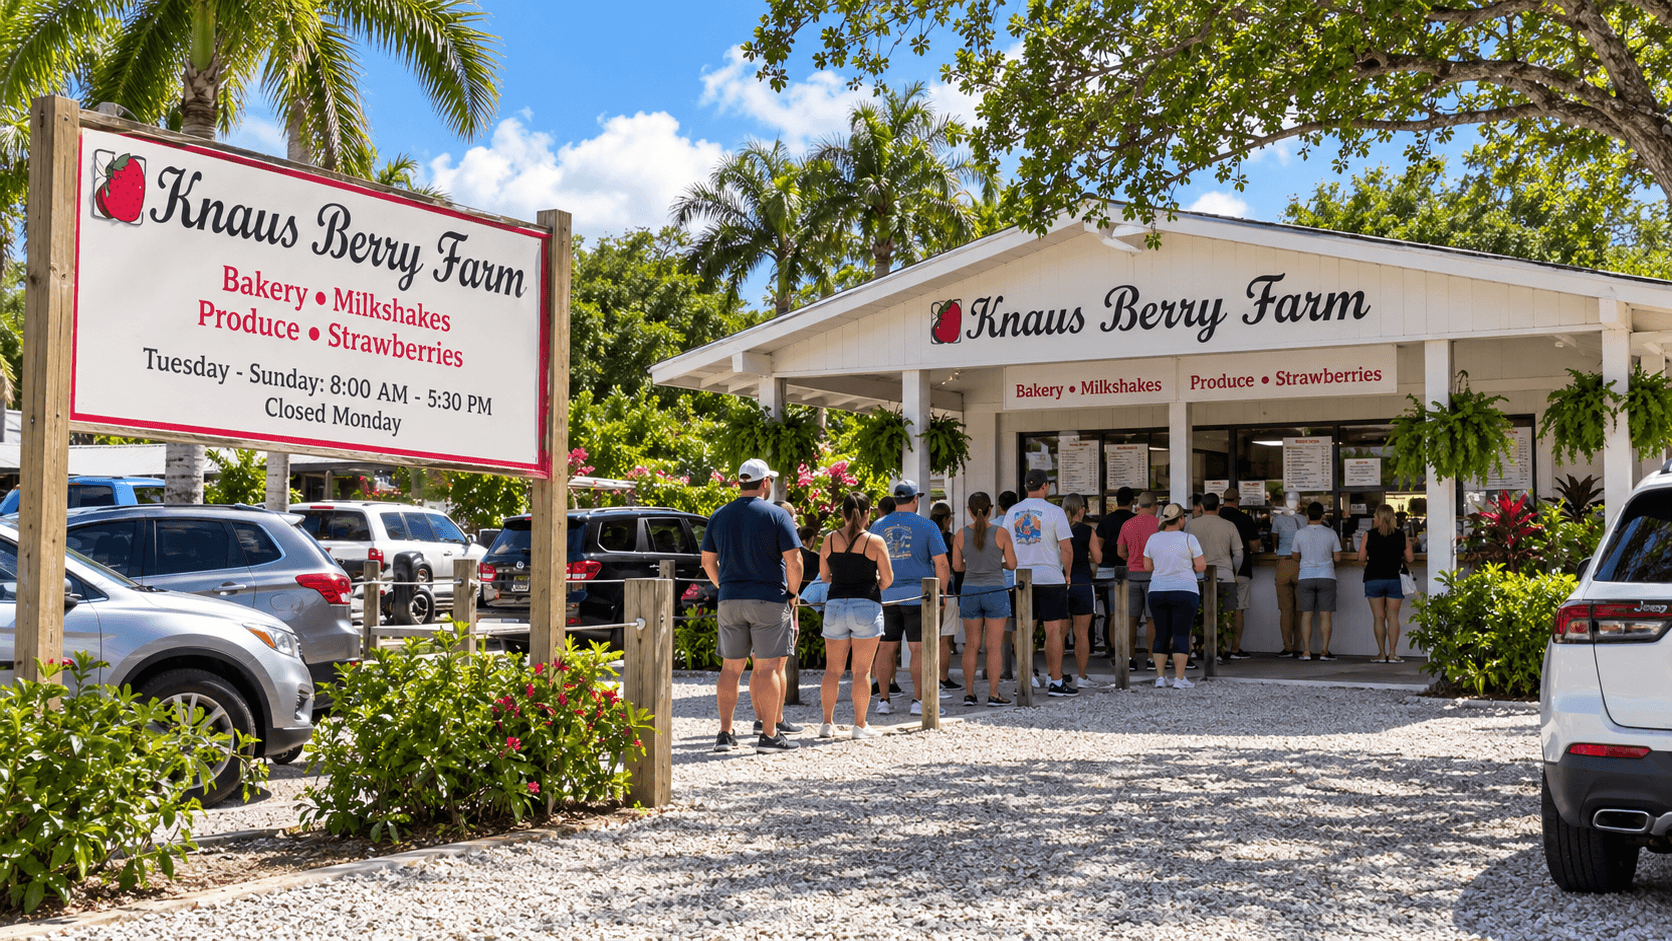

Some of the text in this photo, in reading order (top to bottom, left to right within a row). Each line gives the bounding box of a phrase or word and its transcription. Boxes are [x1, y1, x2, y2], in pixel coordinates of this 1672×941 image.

[149, 165, 527, 299] Knaus Berry Farm
[197, 299, 464, 369] Produce Strawberries
[221, 264, 452, 334] Bakery Milkshakes
[966, 272, 1371, 343] Knaus Berry Farm
[143, 346, 231, 385] Tuesday
[249, 363, 325, 397] Sunday:
[329, 374, 372, 400] 8:00
[376, 382, 409, 405] AM
[427, 389, 463, 412] 5:30
[467, 394, 493, 416] PM
[1015, 377, 1163, 401] Bakery Milkshakes
[1190, 366, 1383, 391] Produce Strawberries
[264, 397, 403, 437] Closed Monday
